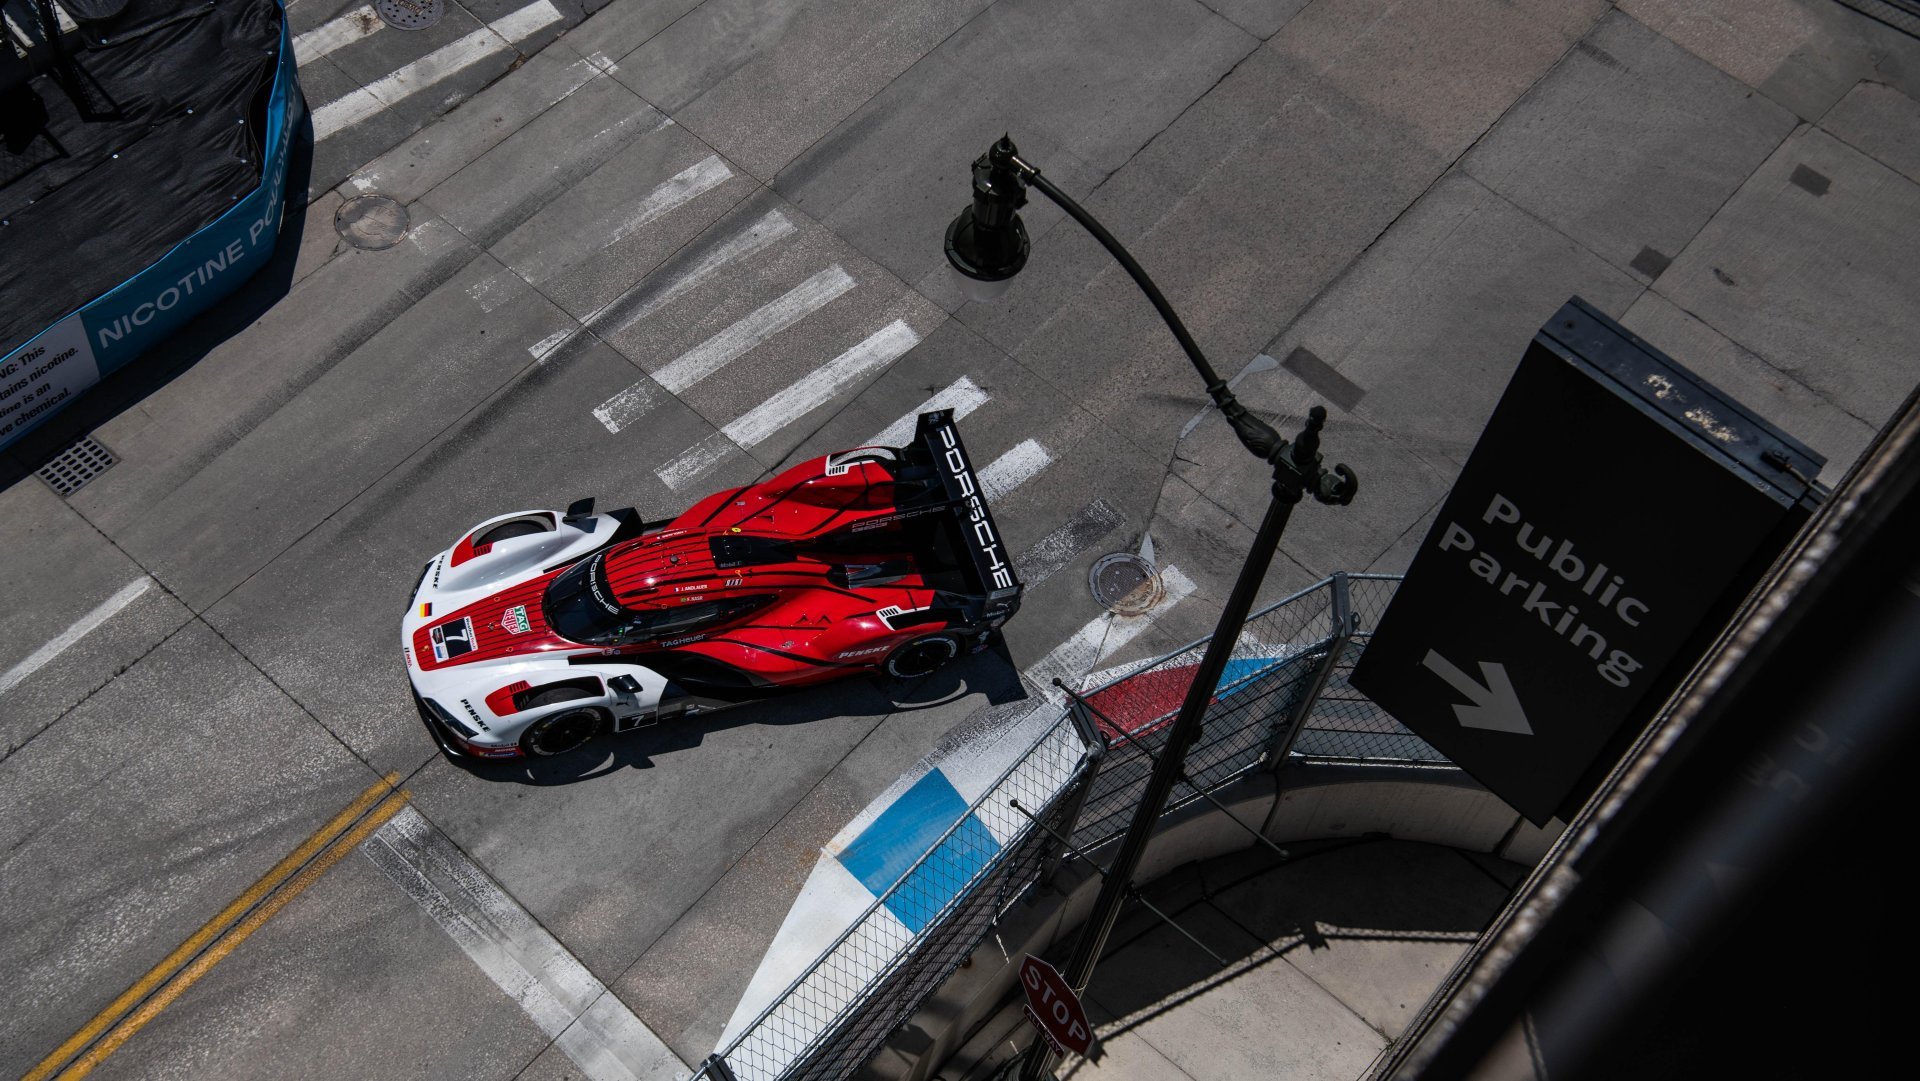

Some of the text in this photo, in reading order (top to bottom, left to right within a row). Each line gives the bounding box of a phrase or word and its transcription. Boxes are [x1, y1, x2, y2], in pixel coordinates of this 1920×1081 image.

[98, 238, 244, 348] NICOTINE
[18, 347, 45, 366] This
[29, 348, 79, 380] nicotine.
[14, 387, 71, 426] chemical.
[23, 394, 34, 404] is
[36, 383, 51, 397] an
[940, 425, 1013, 589] PORSCHE
[1482, 493, 1650, 627] Public
[590, 554, 619, 615] PORSCHE
[503, 608, 519, 634] HEUER
[516, 605, 530, 632] TAG
[1439, 521, 1643, 688] Parking
[446, 628, 469, 642] 7
[838, 645, 889, 659] PENSKE
[460, 698, 491, 733] PENSKE
[631, 714, 645, 727] 7
[1025, 965, 1087, 1041] STOP
